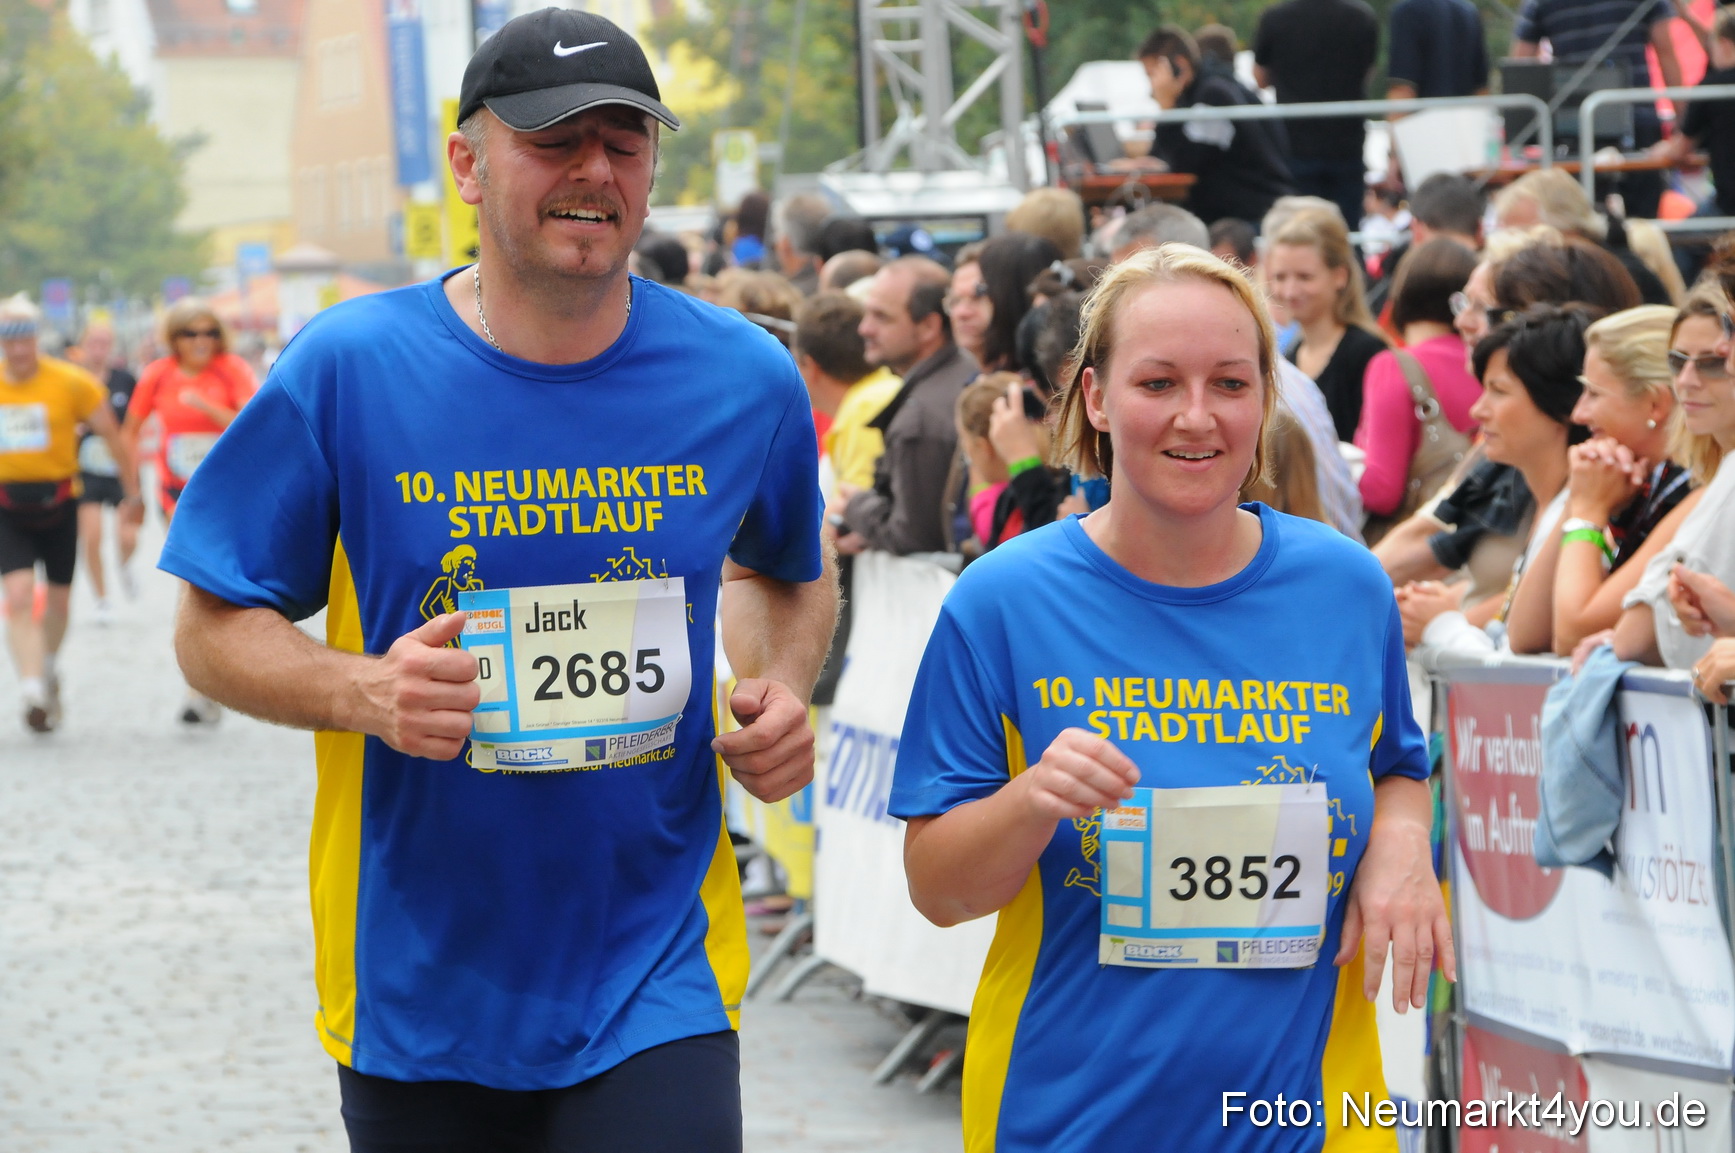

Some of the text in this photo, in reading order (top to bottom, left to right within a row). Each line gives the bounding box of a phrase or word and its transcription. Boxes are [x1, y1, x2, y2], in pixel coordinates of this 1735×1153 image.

[395, 464, 708, 503] 10. NEUMARKTER
[448, 500, 663, 538] STADTLAUF
[524, 599, 588, 633] Jack
[478, 657, 492, 680] D
[531, 648, 666, 702] 2685
[1032, 676, 1351, 716] 10. NEUMARKTER
[610, 722, 674, 751] PFLEIDERER
[1087, 710, 1311, 744] STADTLAUF
[1456, 715, 1482, 772] Wir
[496, 747, 553, 761] BOCK
[1464, 798, 1486, 851] im
[1168, 855, 1301, 902] 3852
[1124, 944, 1183, 958] BOCK
